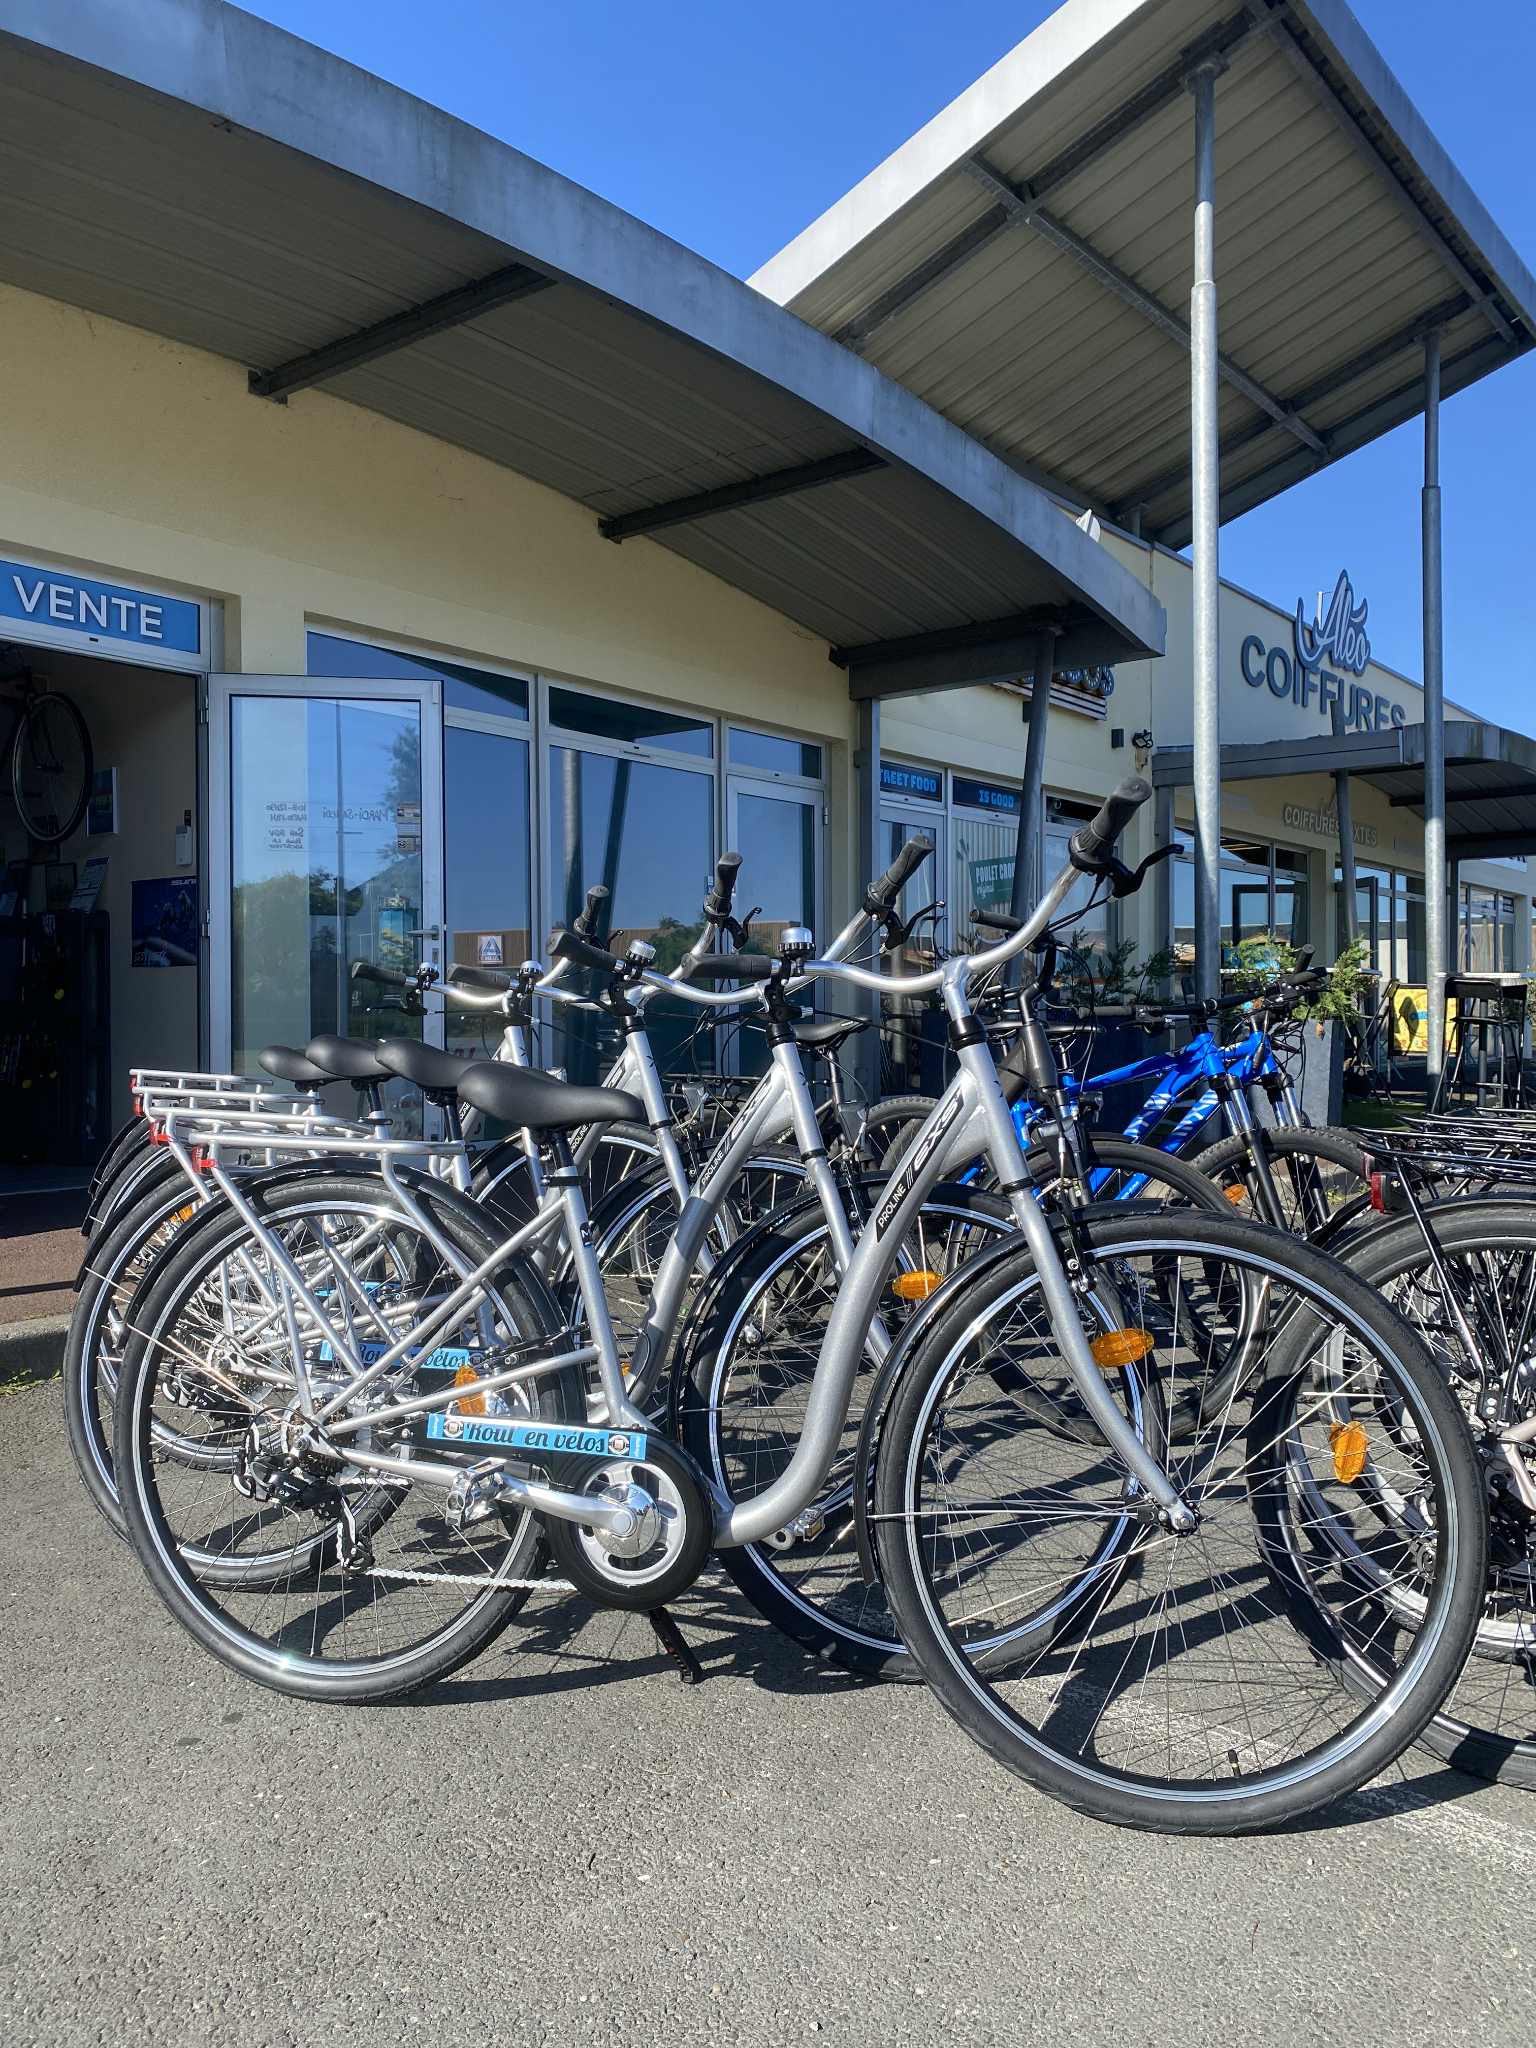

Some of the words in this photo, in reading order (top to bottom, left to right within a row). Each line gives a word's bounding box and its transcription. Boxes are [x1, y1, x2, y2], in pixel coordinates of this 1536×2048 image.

[13, 575, 163, 639] VENTE
[1241, 634, 1406, 733] COIFFURES
[910, 774, 937, 793] FOOD
[978, 789, 990, 804] IS
[991, 791, 1015, 808] GOOD
[702, 1149, 725, 1185] PROLINE
[878, 1183, 907, 1229] PROLINE
[524, 1430, 549, 1447] en
[553, 1431, 605, 1452] vélos
